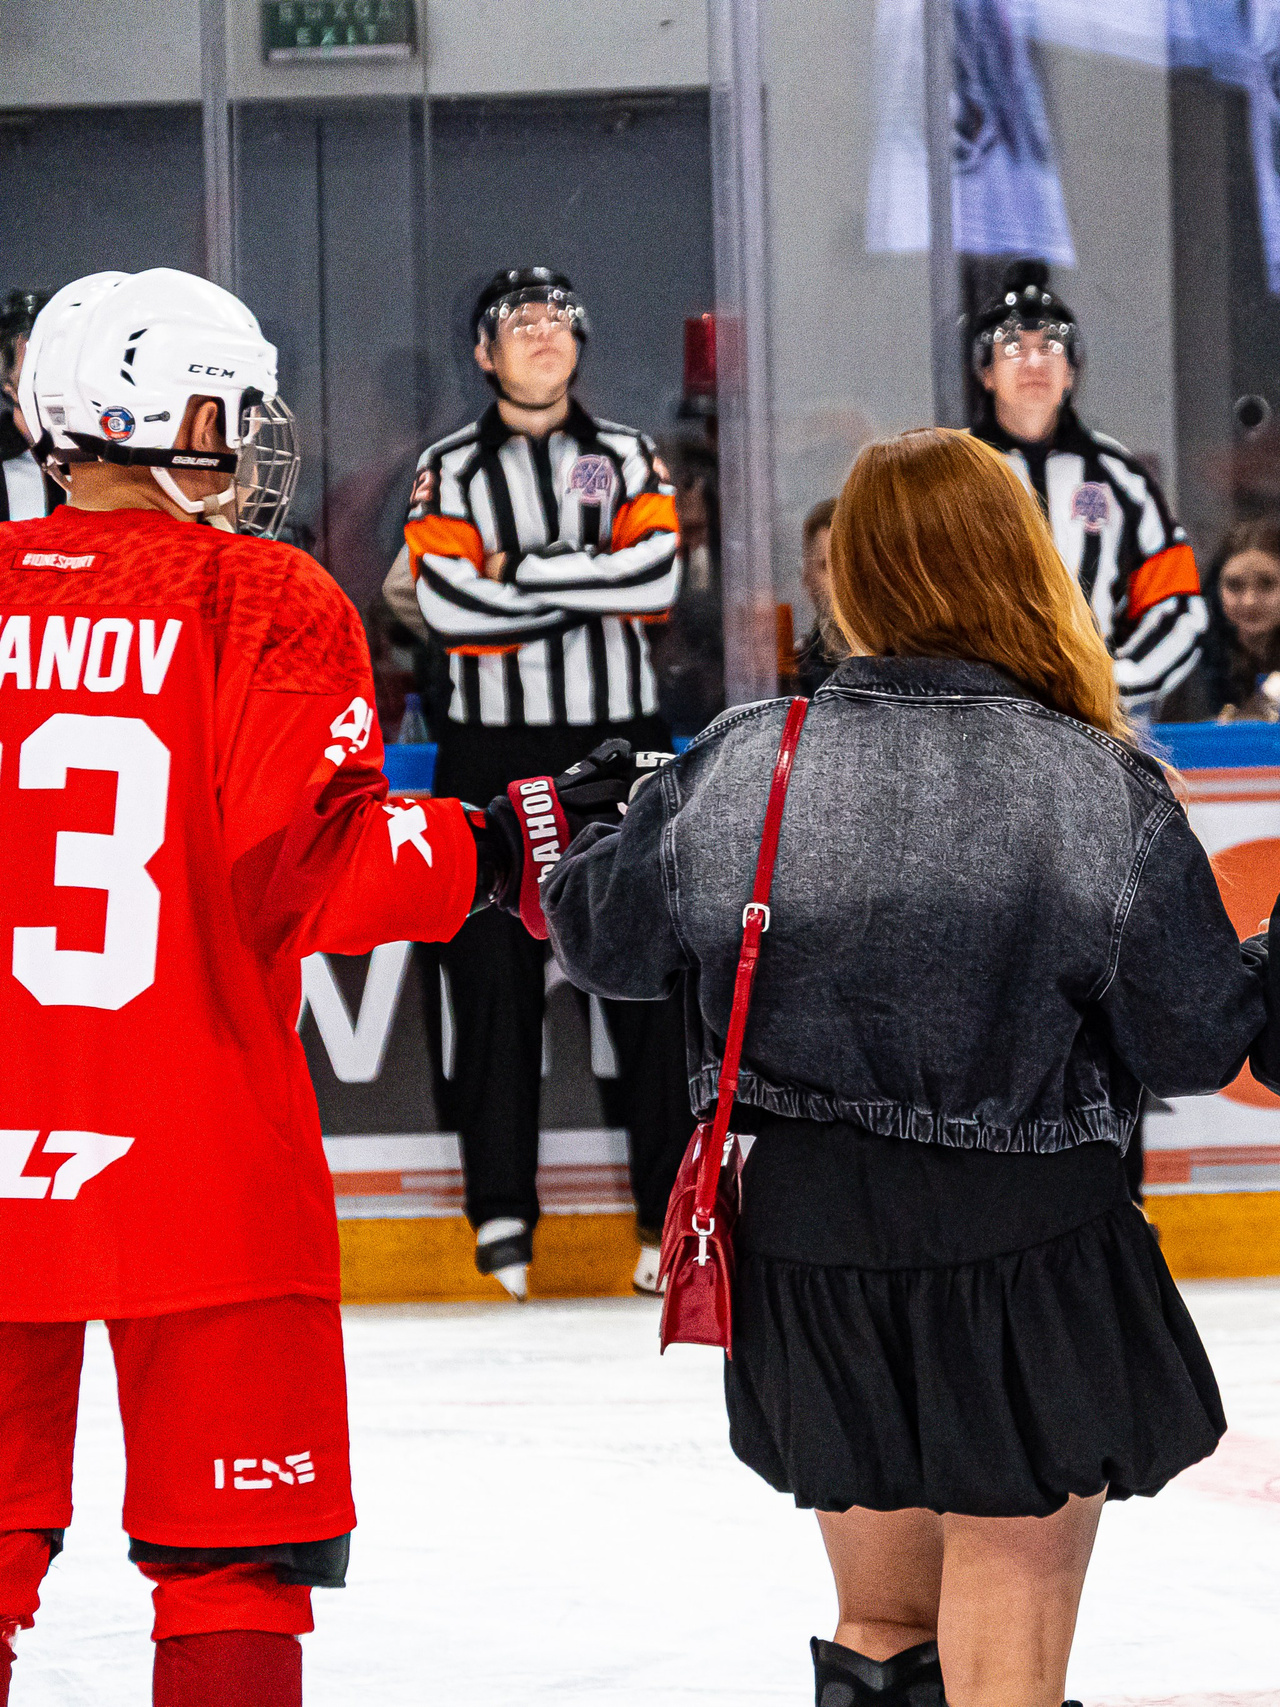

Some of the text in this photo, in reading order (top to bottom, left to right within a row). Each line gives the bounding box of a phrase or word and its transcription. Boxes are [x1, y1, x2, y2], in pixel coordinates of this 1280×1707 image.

[188, 363, 235, 379] CCM
[0, 615, 184, 695] ANOV
[0, 713, 172, 1011] 3
